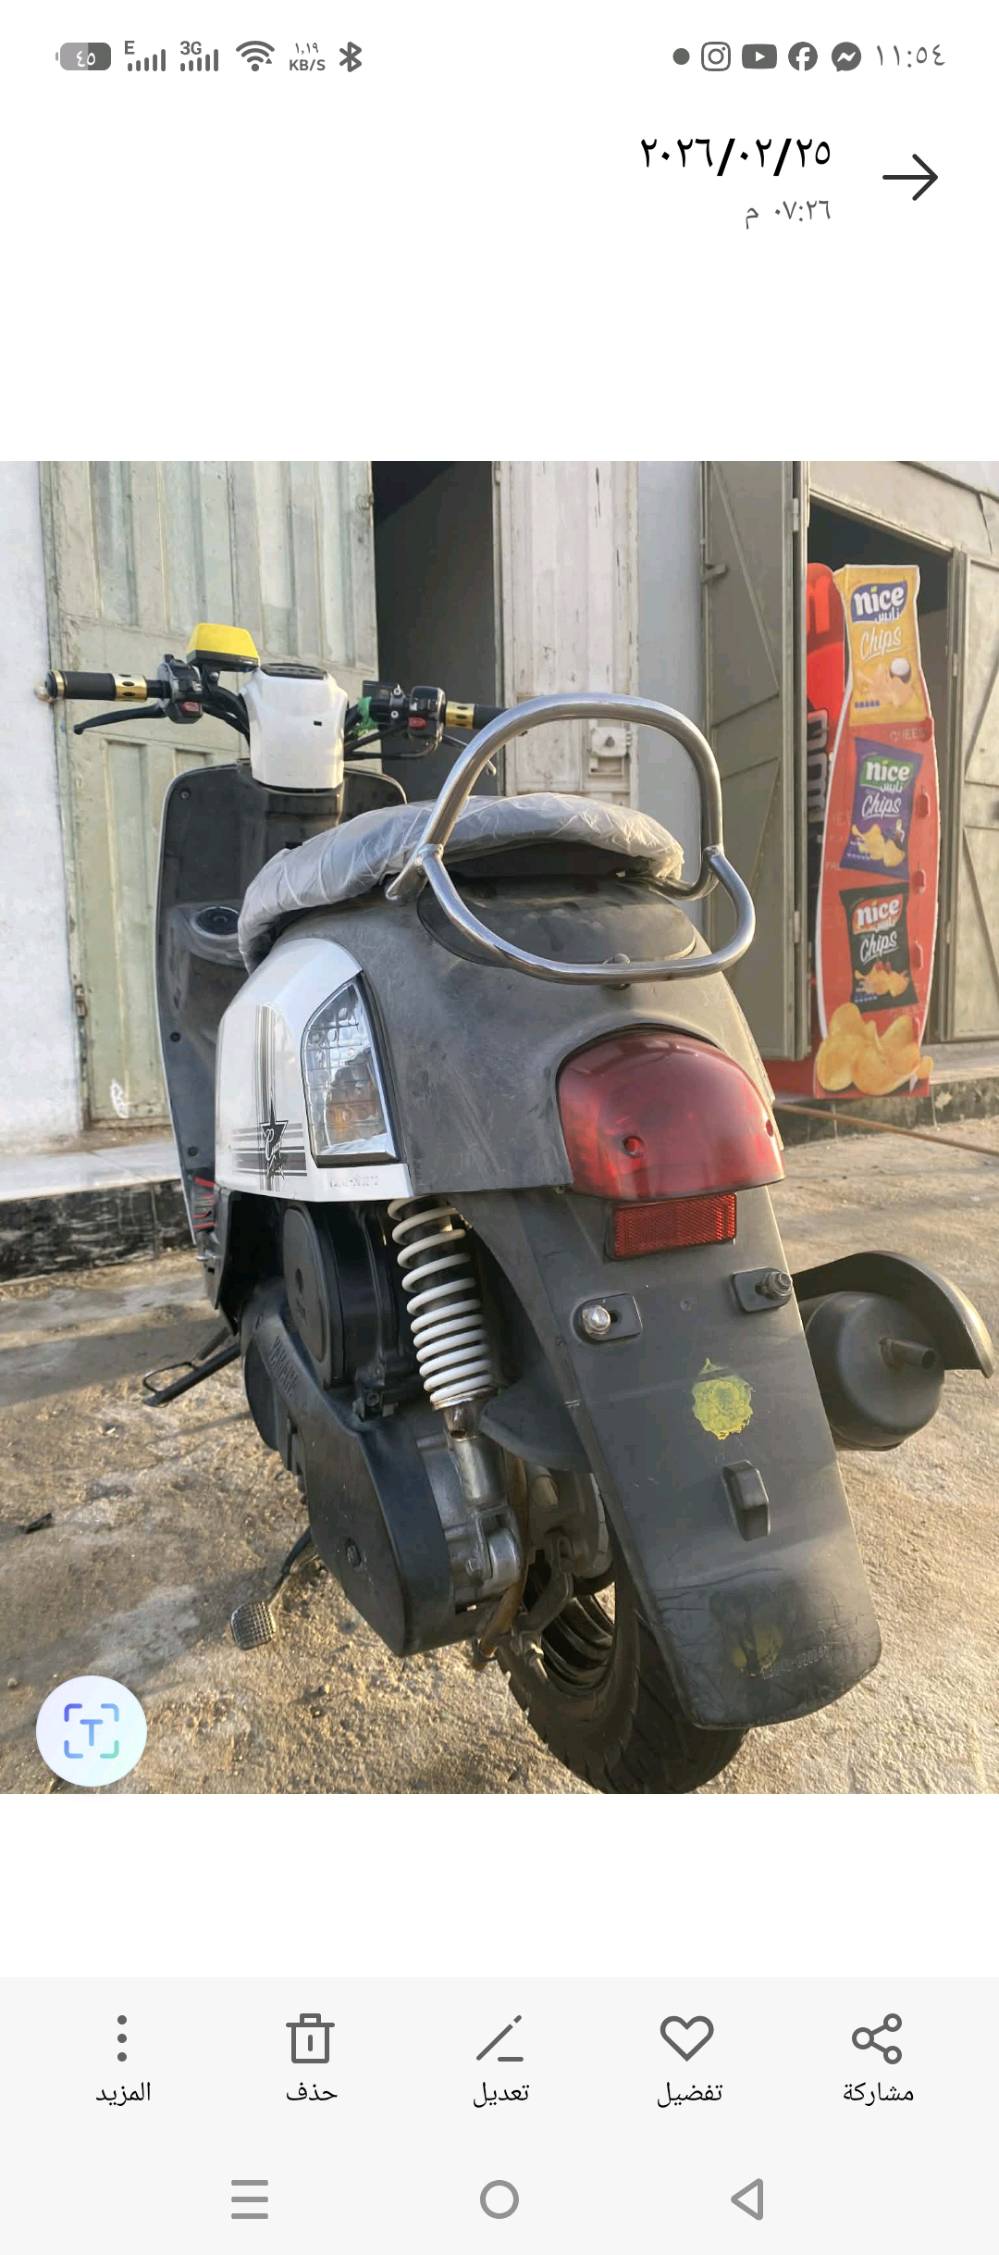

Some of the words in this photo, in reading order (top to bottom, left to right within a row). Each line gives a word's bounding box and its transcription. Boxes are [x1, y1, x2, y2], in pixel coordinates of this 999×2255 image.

[854, 586, 904, 616] nice
[861, 625, 901, 660] Chips
[865, 760, 910, 782] nice
[862, 792, 901, 820] Chips
[856, 898, 900, 928] nice
[860, 931, 898, 965] Chips
